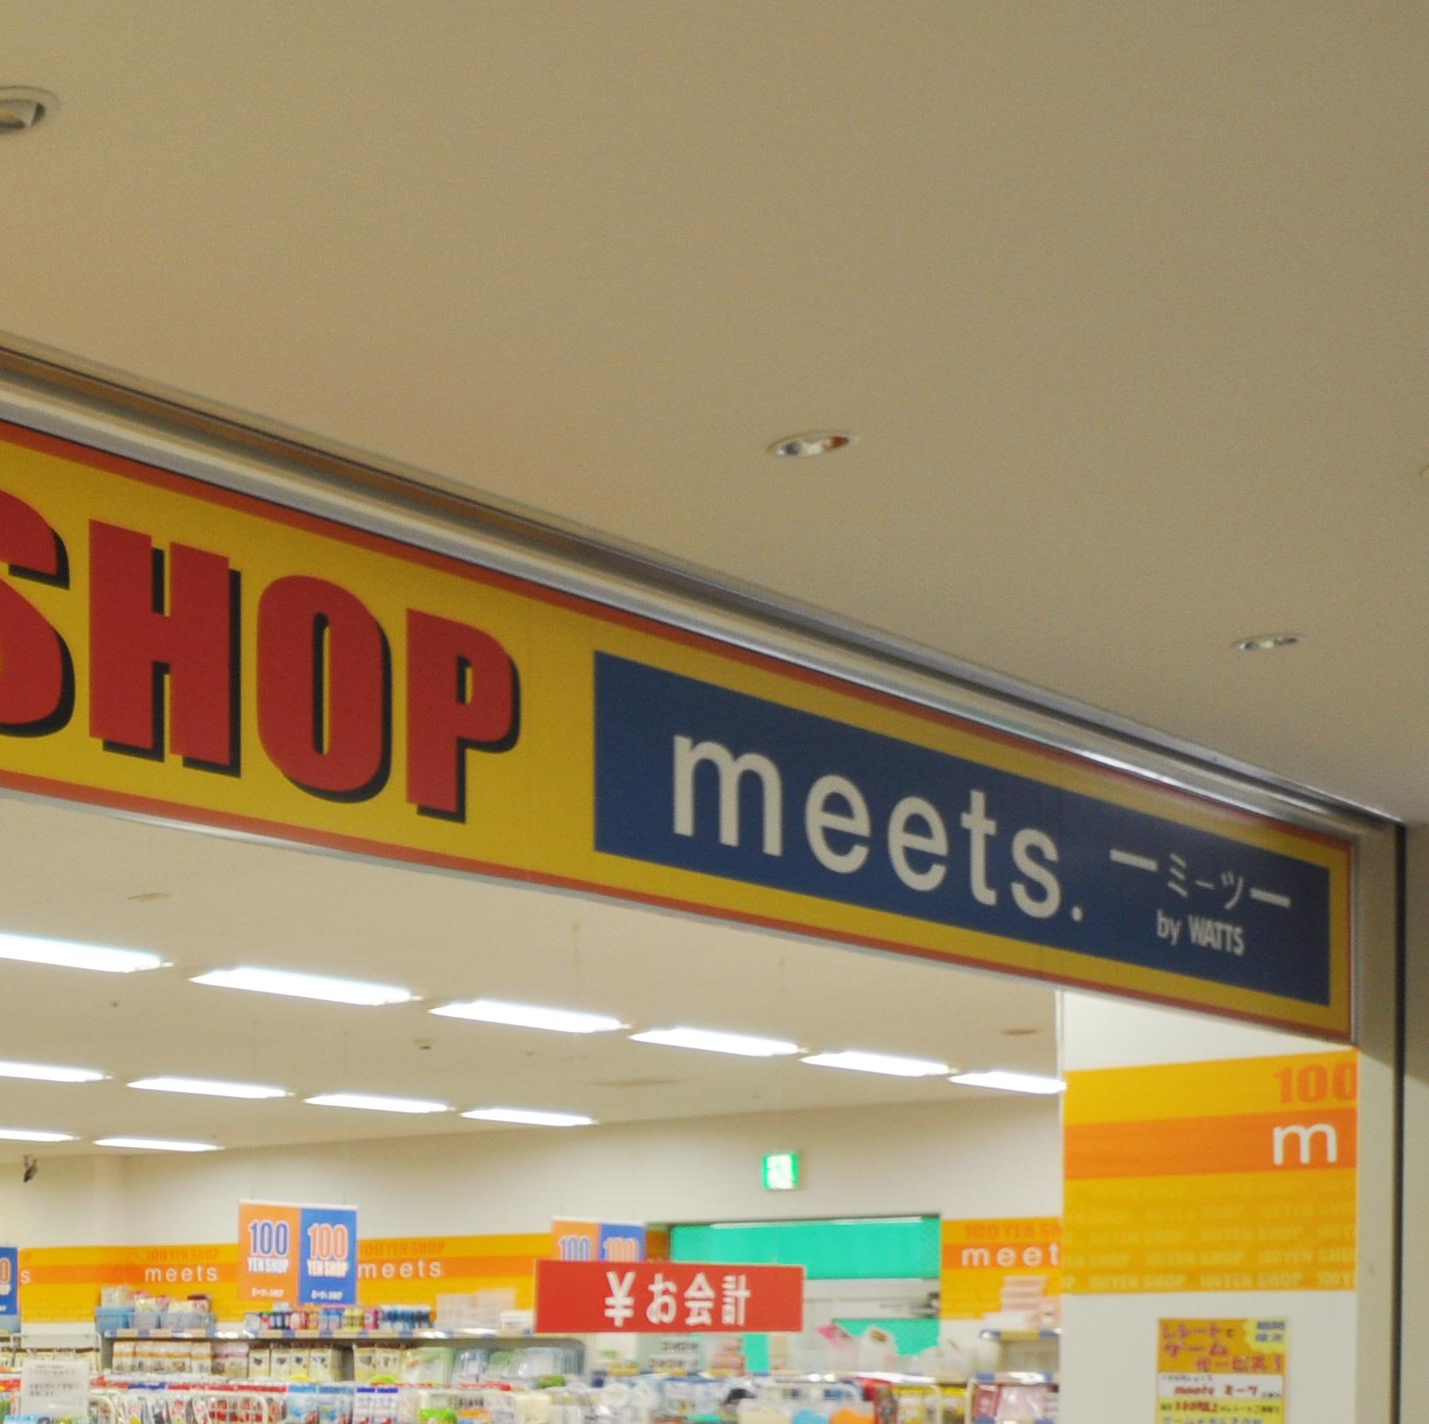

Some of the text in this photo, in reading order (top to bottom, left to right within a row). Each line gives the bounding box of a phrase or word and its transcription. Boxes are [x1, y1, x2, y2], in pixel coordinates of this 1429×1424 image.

[1156, 909, 1246, 957] by WATTS
[248, 1219, 289, 1257] 100
[307, 1223, 348, 1260] 100
[357, 1260, 442, 1279] meets
[961, 1244, 1060, 1267] meet
[144, 1264, 218, 1282] meets
